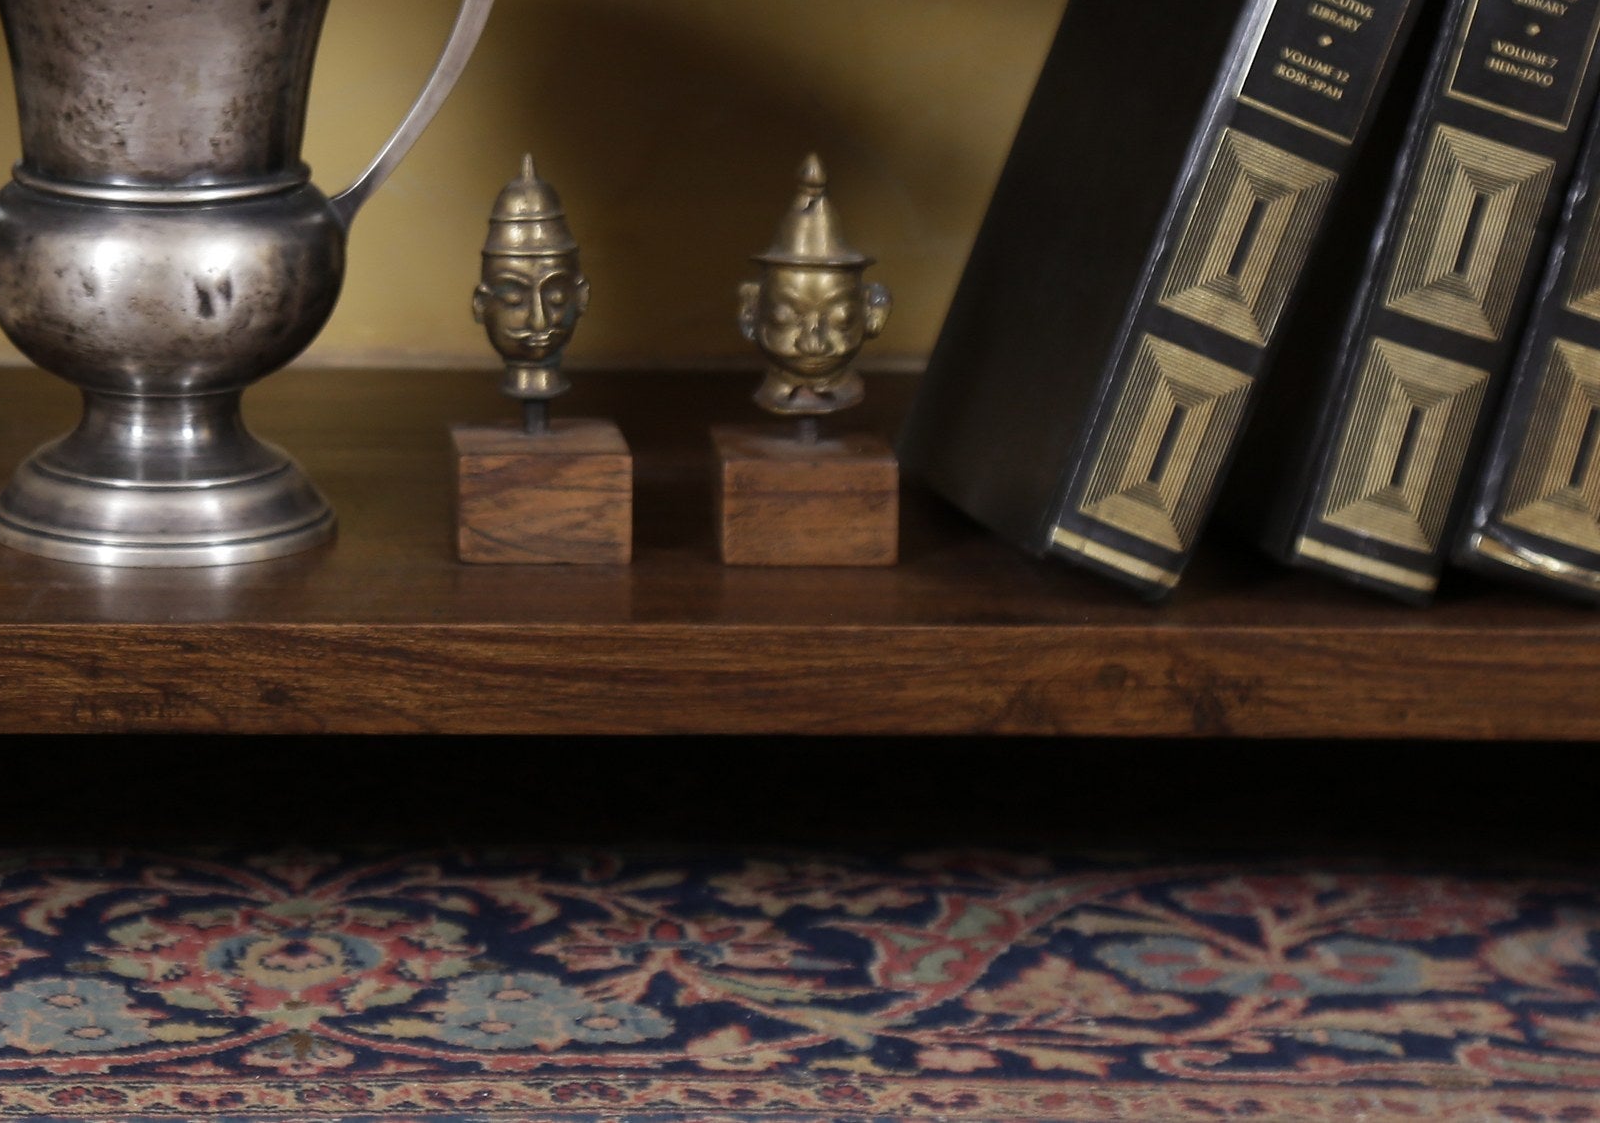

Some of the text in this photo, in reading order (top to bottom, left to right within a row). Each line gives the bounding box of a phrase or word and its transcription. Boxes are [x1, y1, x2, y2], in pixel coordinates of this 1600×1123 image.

[1310, 2, 1362, 33] LIBRARY
[1282, 46, 1351, 84] VOLUME 12
[1494, 38, 1550, 66] VOLUME
